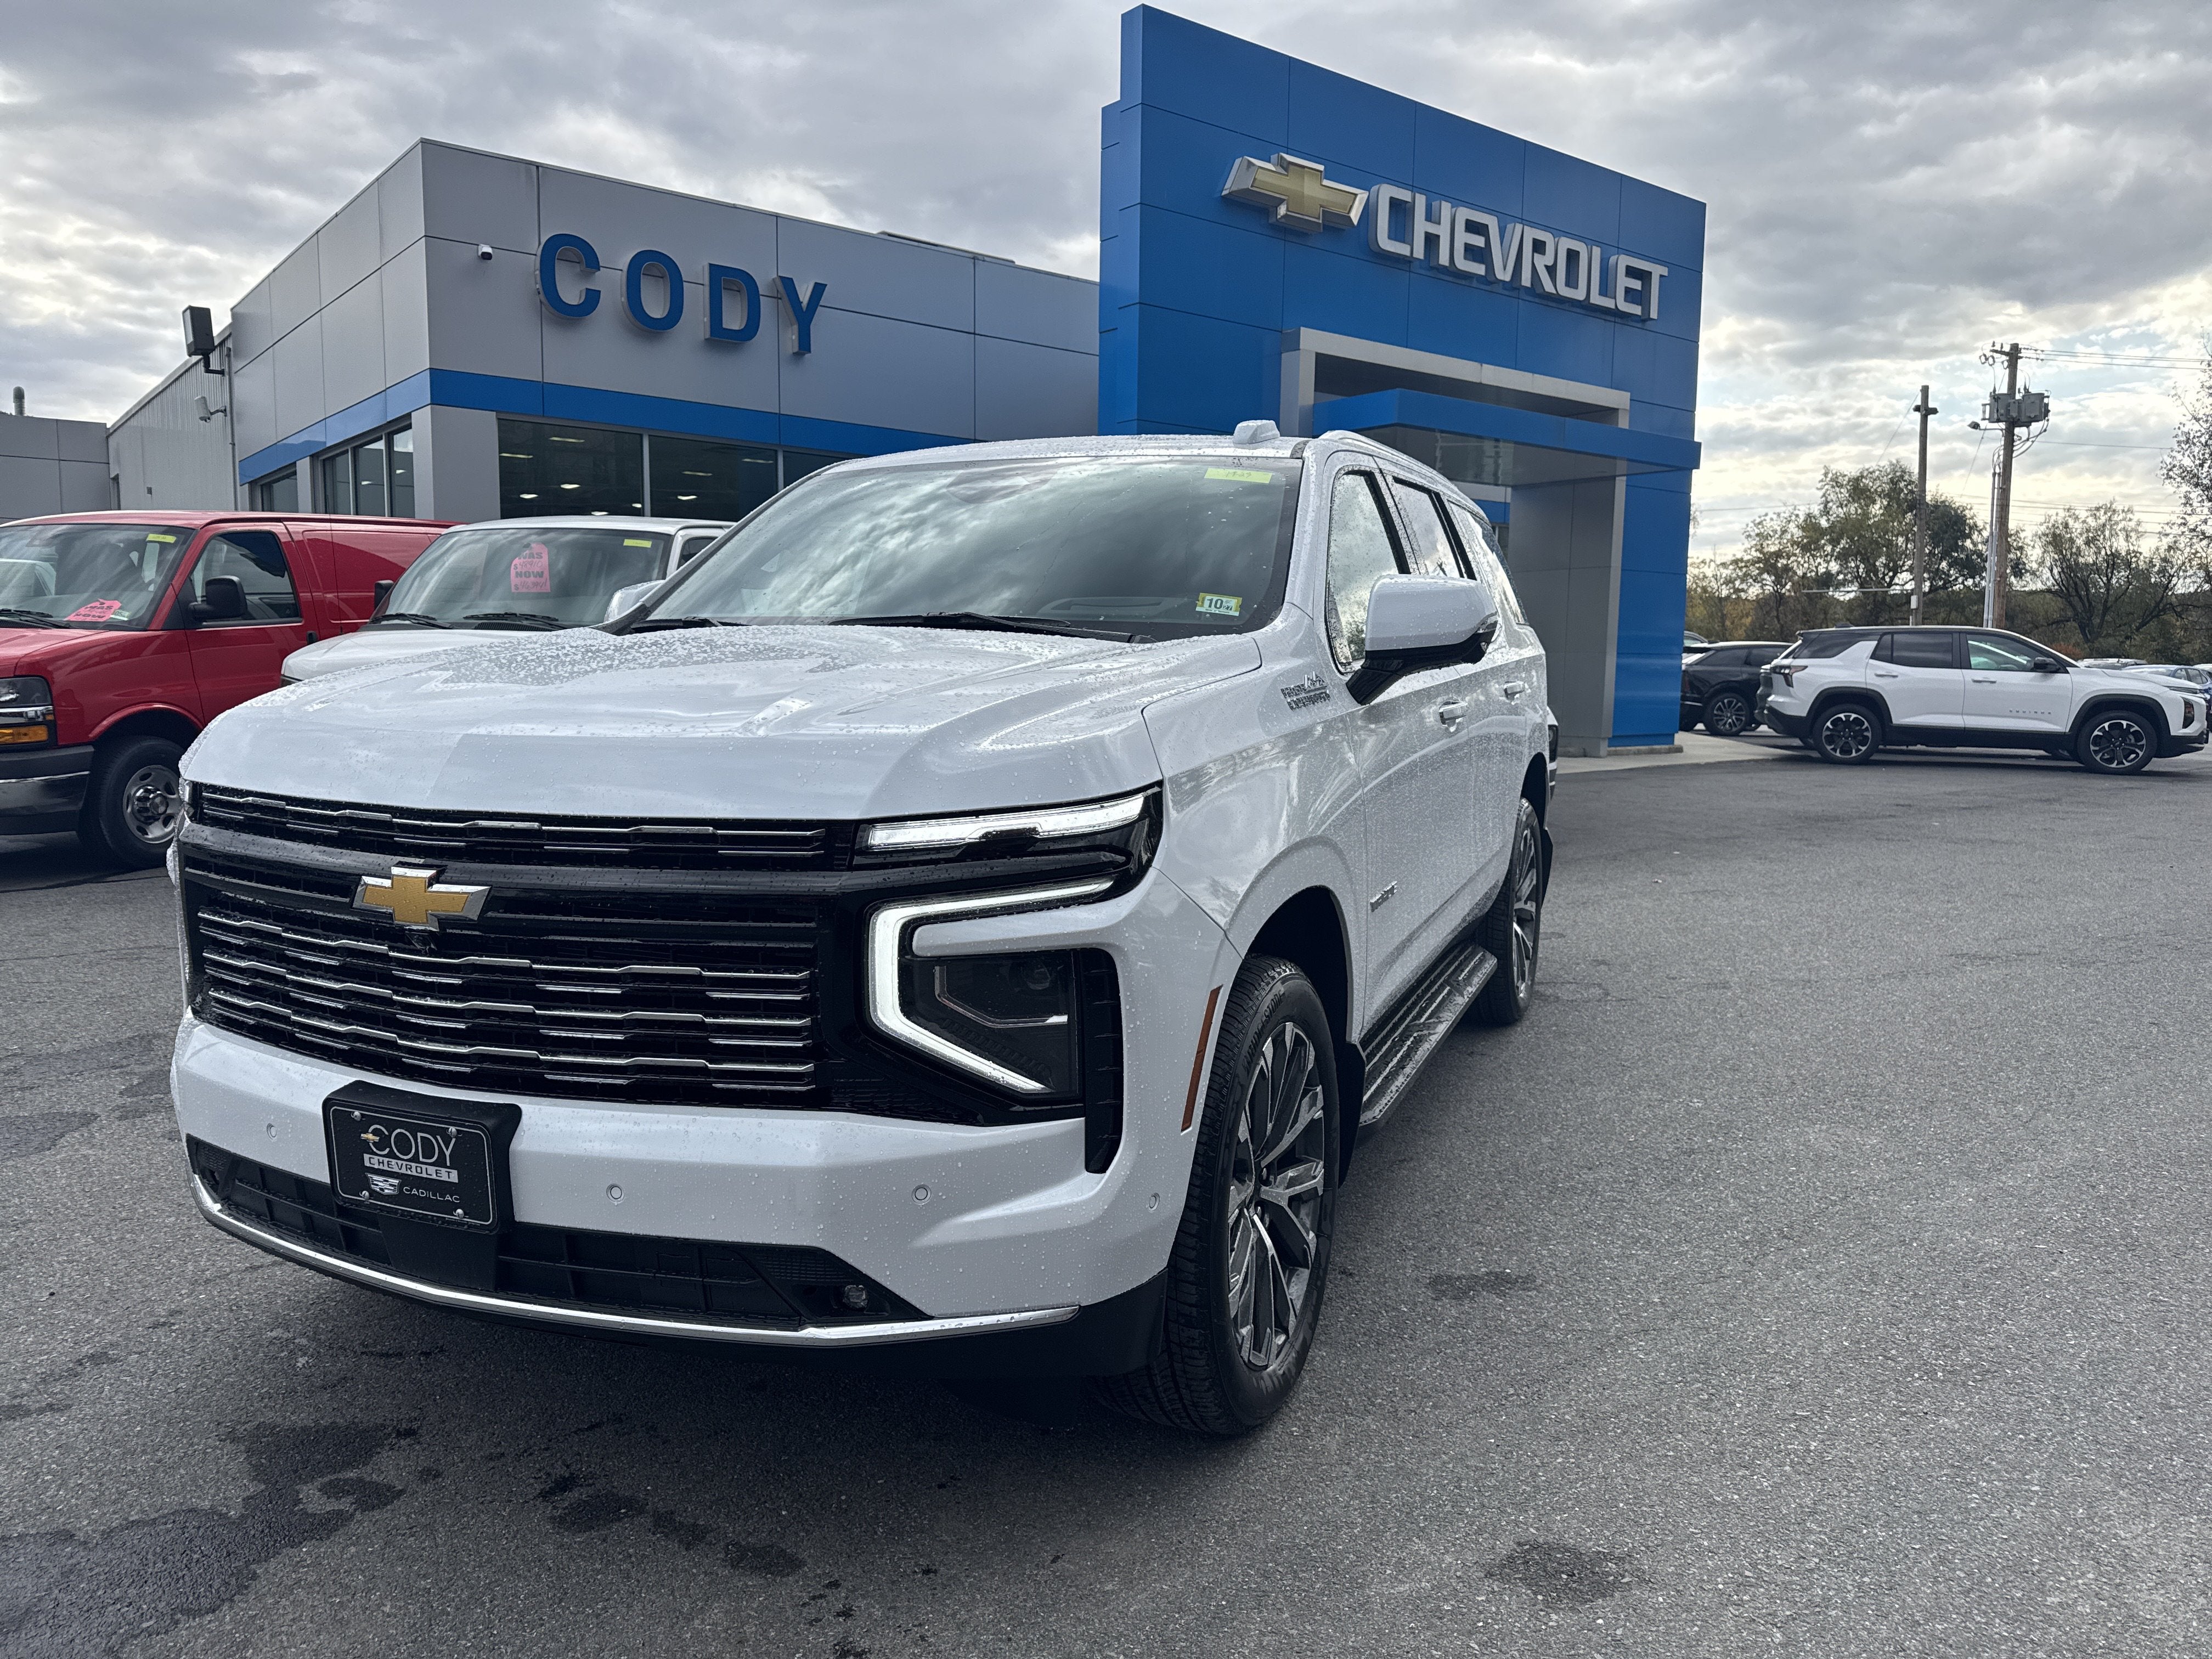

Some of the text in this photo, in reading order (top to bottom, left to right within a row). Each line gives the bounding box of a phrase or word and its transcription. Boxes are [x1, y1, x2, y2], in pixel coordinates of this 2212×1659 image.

[1368, 183, 1668, 321] CHEVROLET
[534, 233, 828, 354] CODY
[1207, 597, 1224, 610] 10
[368, 1124, 456, 1166] CODY
[368, 1156, 453, 1180] CHEVROLET
[403, 1186, 460, 1203] CADILLAC
